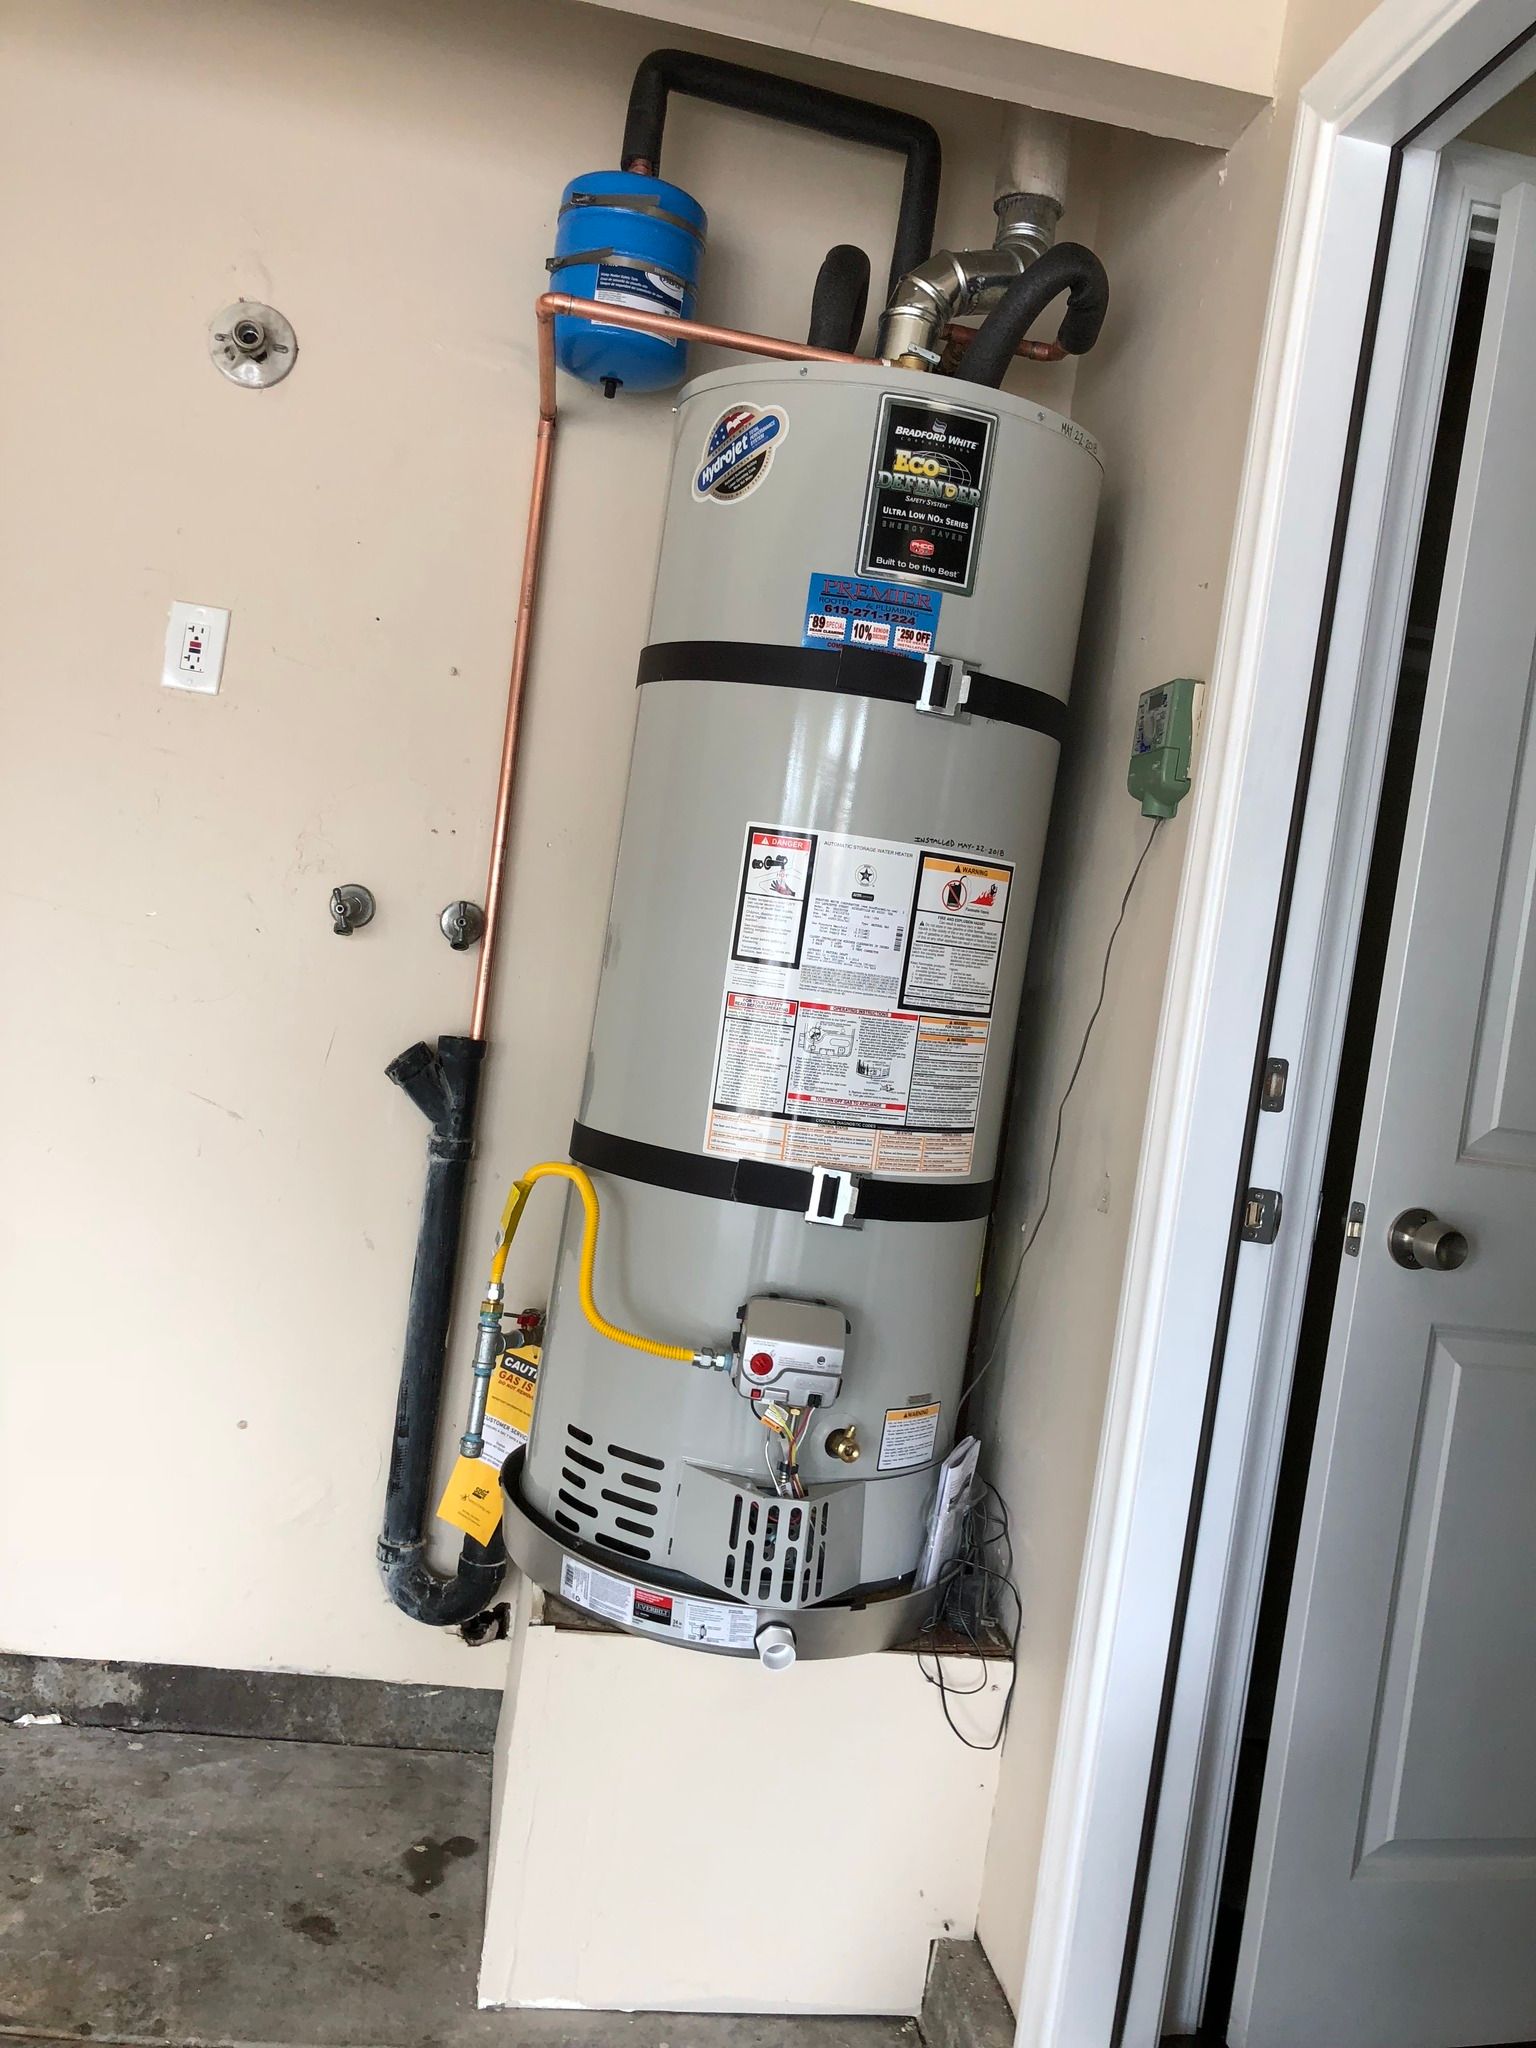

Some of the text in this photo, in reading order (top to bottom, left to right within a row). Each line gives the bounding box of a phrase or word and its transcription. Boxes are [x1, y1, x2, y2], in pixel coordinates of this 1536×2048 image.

[895, 426, 978, 450] BRADFORD WHITE
[900, 436, 970, 454] CORPORATION
[702, 434, 748, 485] Hydrojet
[876, 470, 981, 507] DEFENDER
[905, 495, 926, 506] SAFETY
[883, 506, 907, 517] ULTRA
[909, 510, 926, 519] LOW
[945, 518, 969, 530] SERIES
[882, 520, 963, 542] ENERGY SAVER
[876, 556, 957, 578] Built to be the Best
[824, 579, 932, 609] PREMIER
[819, 596, 852, 606] ROOTER
[875, 604, 920, 617] PLUMBING
[824, 604, 916, 625] 619-271-1224
[826, 621, 844, 630] SPECIAL
[853, 623, 873, 641] 10%
[915, 631, 931, 643] OFF
[771, 839, 803, 849] DANGER
[824, 841, 853, 849] AUTOMATIC
[853, 844, 876, 852] STORAGE
[914, 837, 955, 848] INSTALLED
[962, 867, 988, 876] WARNING
[499, 1370, 533, 1392] GAS IS
[507, 1383, 516, 1392] NOT
[907, 1409, 929, 1418] WARNING
